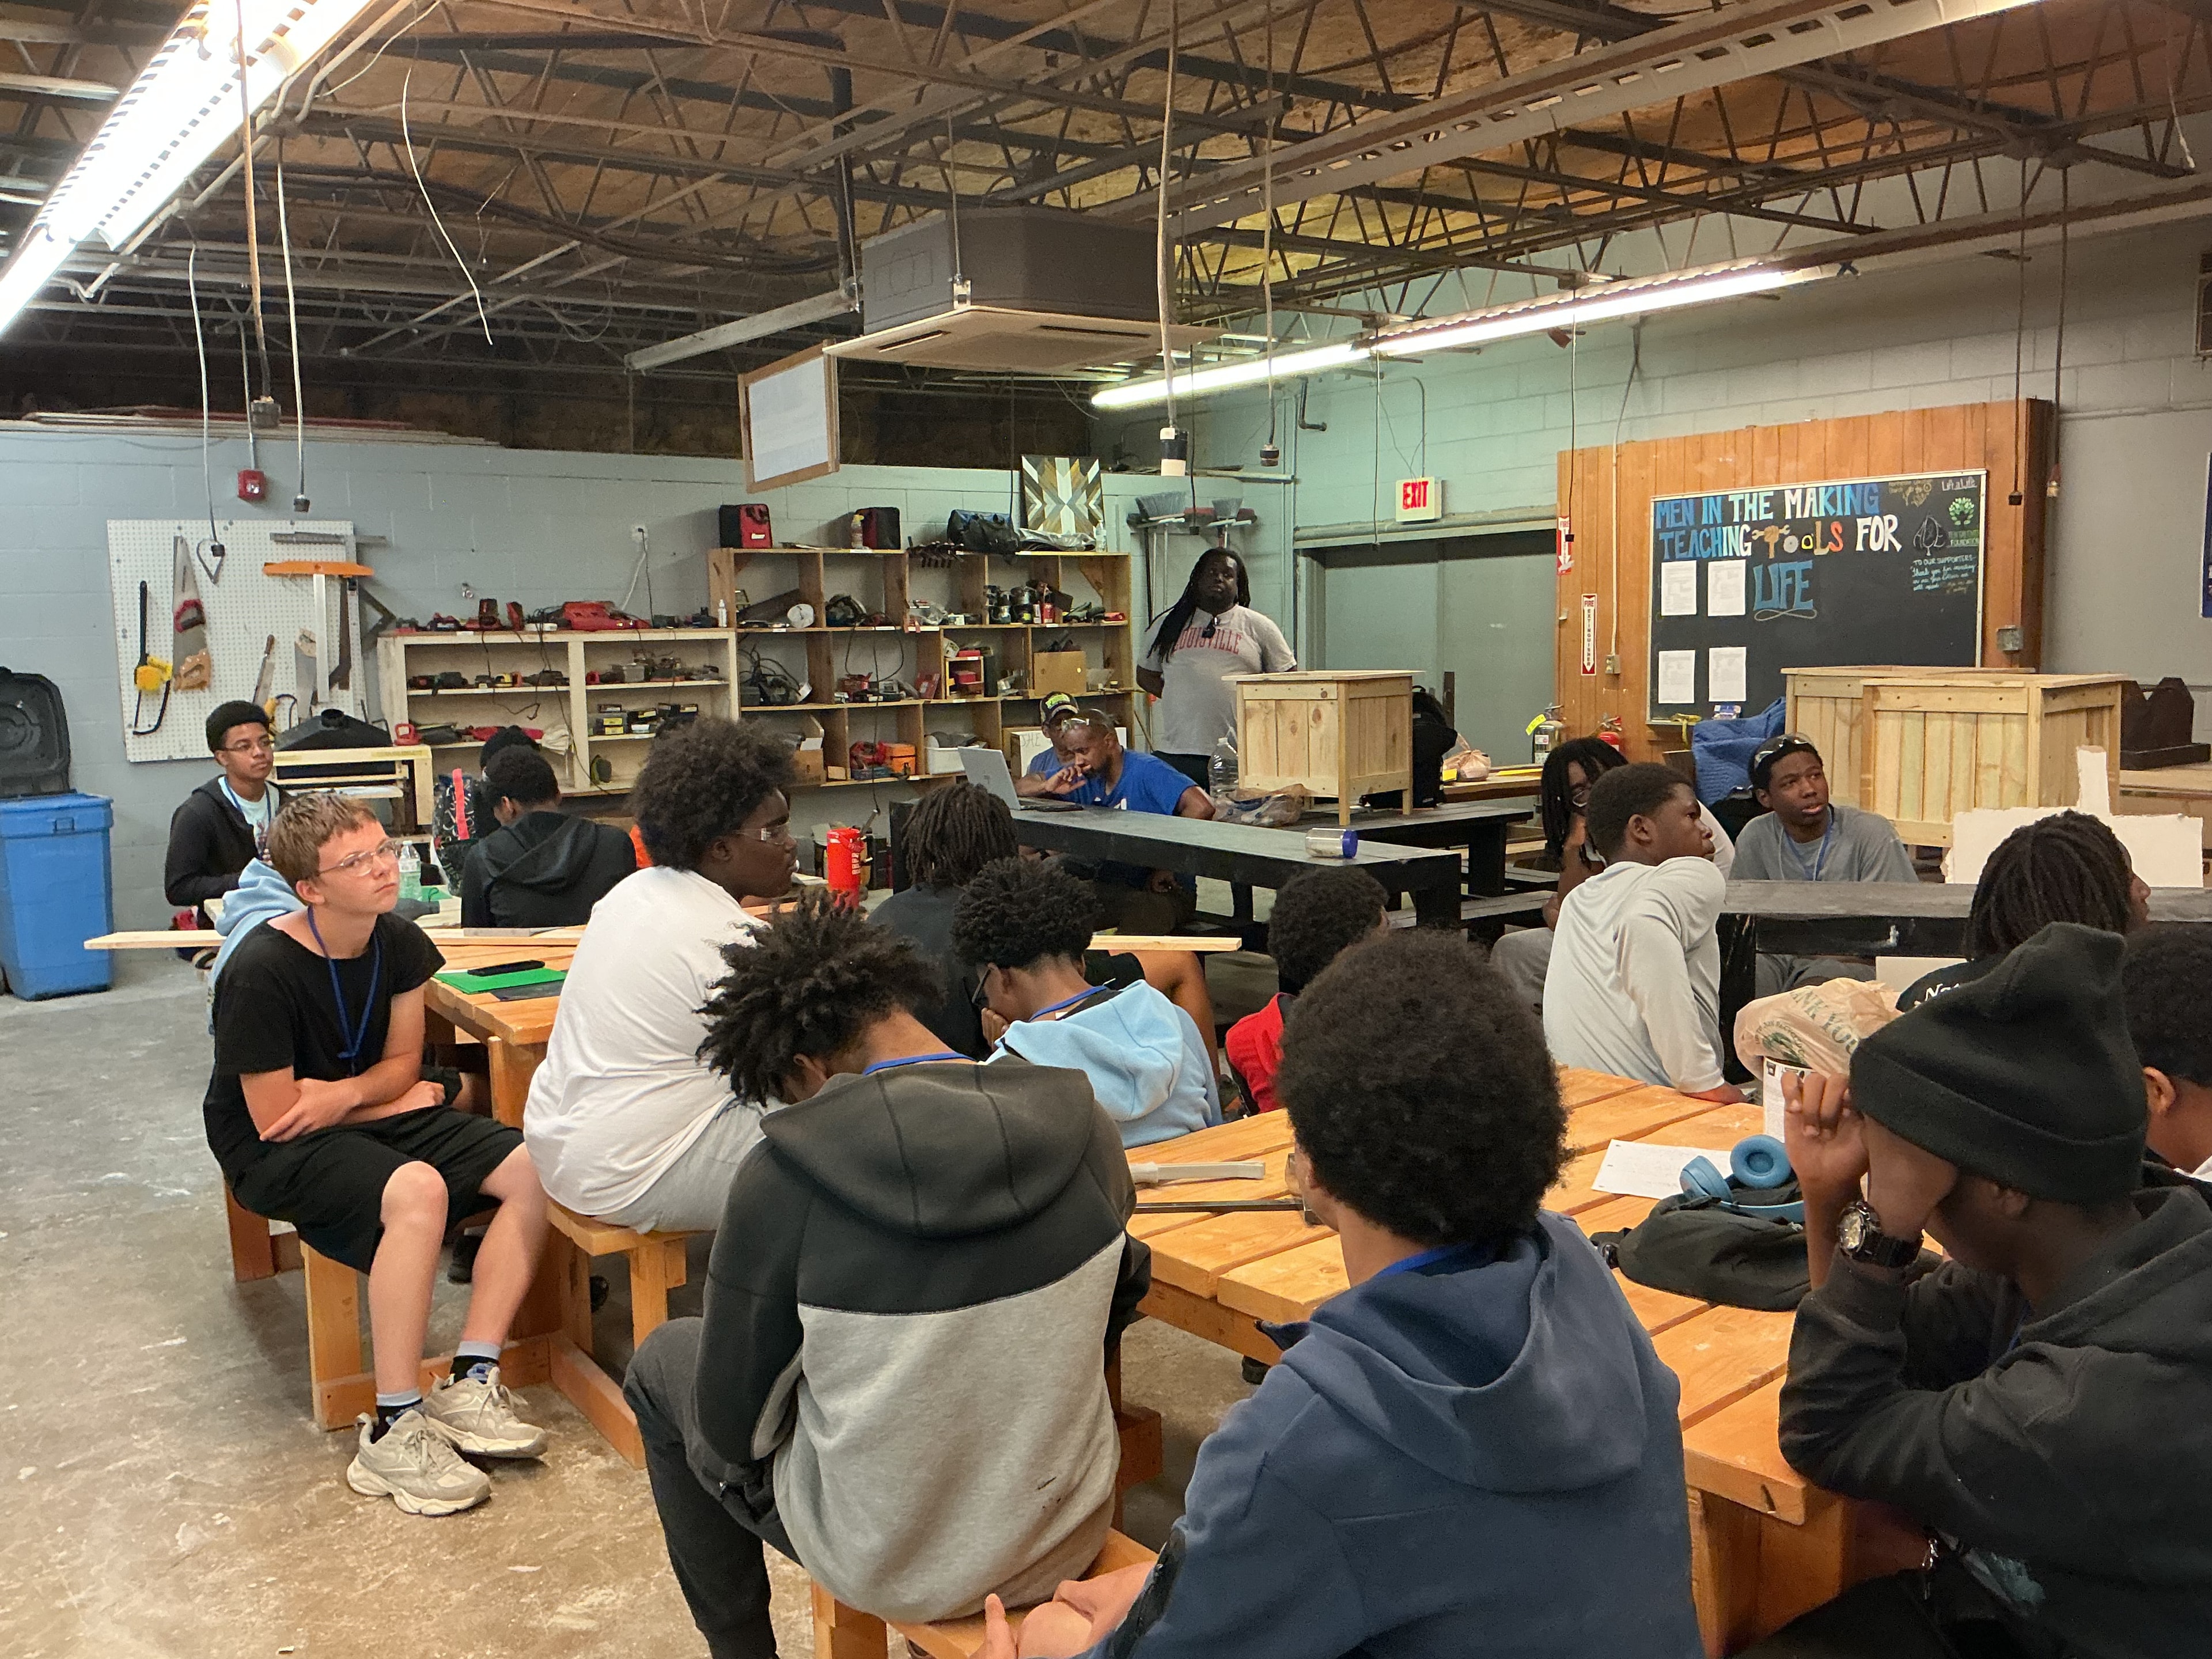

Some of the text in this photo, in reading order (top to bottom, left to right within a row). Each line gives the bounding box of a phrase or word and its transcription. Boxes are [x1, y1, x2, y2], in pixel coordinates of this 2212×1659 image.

[1403, 481, 1429, 509] EXIT
[1655, 499, 1695, 529] MEN
[1701, 496, 1722, 525] IN
[1728, 490, 1774, 523] THE
[1784, 483, 1880, 520] MAKING
[1658, 524, 1752, 559] TEACHING
[1856, 514, 1902, 554] FOR
[1753, 560, 1814, 611] LIFE
